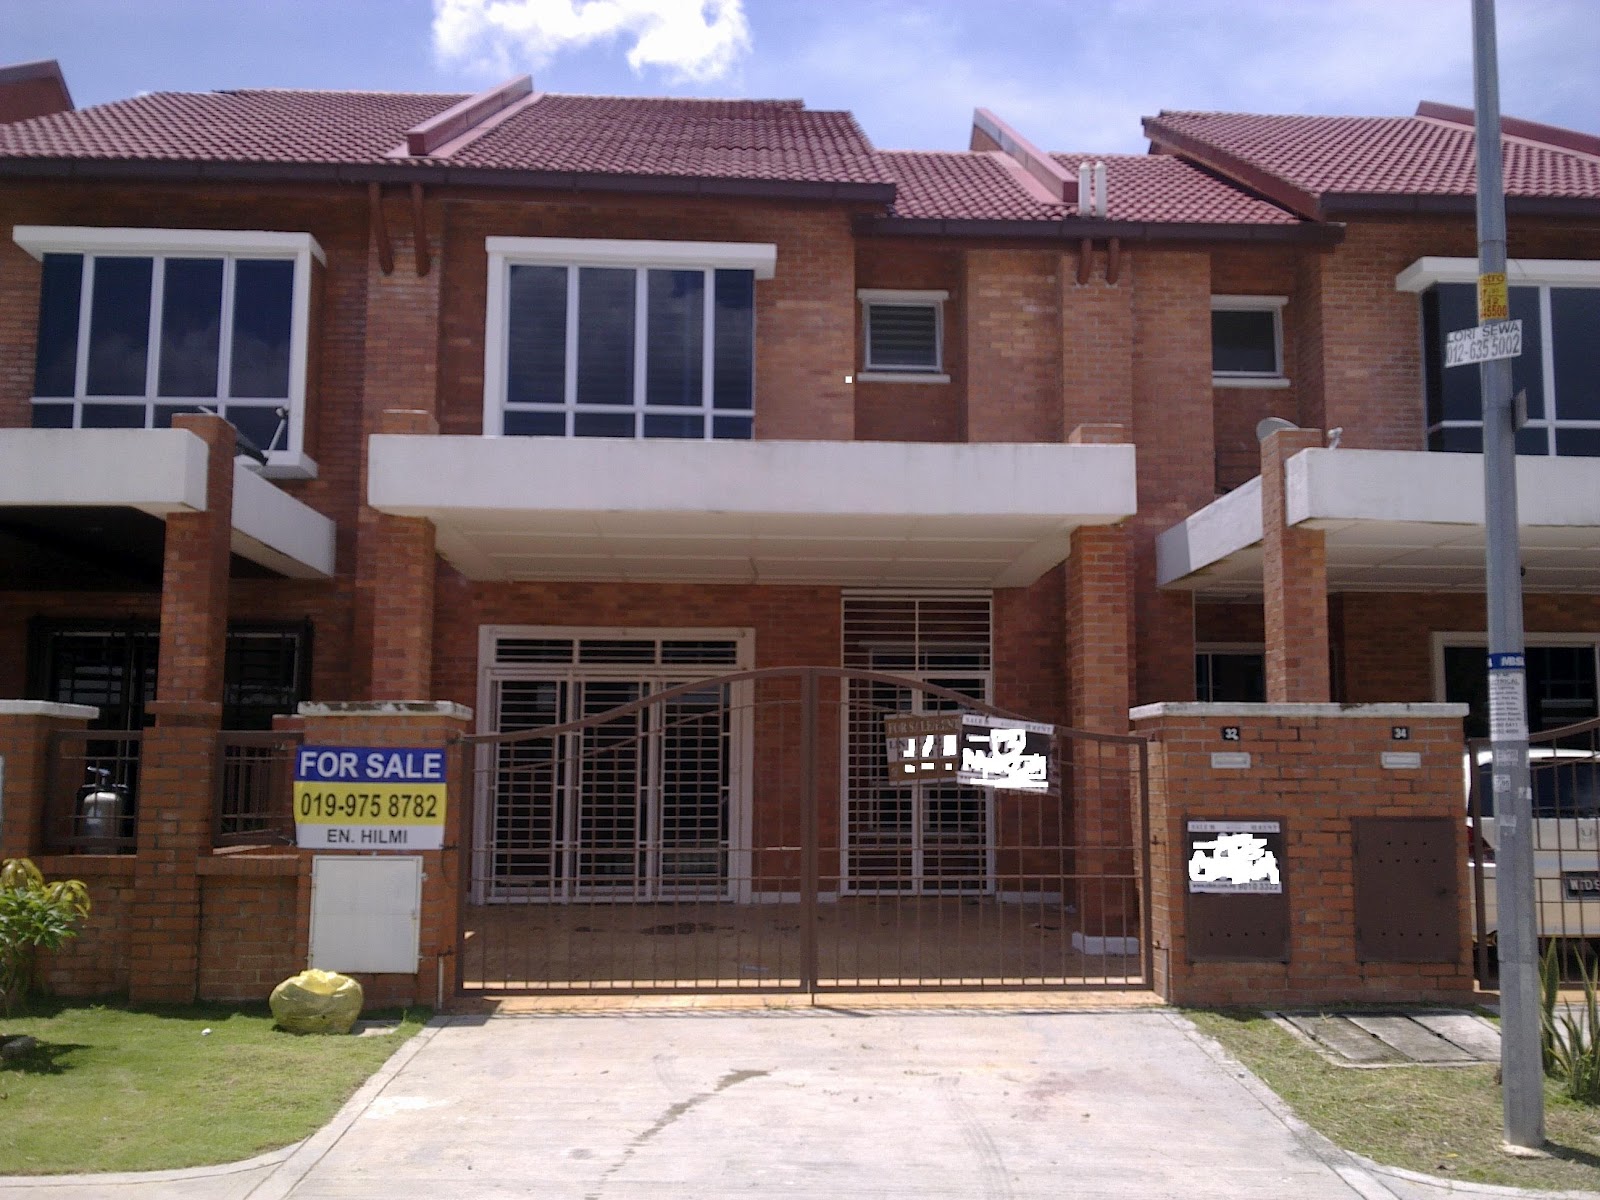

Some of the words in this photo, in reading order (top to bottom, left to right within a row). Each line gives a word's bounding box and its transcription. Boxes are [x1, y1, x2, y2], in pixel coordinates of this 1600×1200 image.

[1482, 321, 1520, 337] SEWA
[1447, 339, 1489, 363] 012-635
[1491, 333, 1520, 357] 5002
[1225, 728, 1239, 741] 32
[1395, 728, 1407, 739] 34
[300, 751, 359, 778] FOR
[365, 752, 442, 779] SALE
[301, 793, 381, 817] 019-975
[388, 794, 437, 818] 8782
[327, 828, 354, 843] EN.
[361, 830, 408, 844] HILMI
